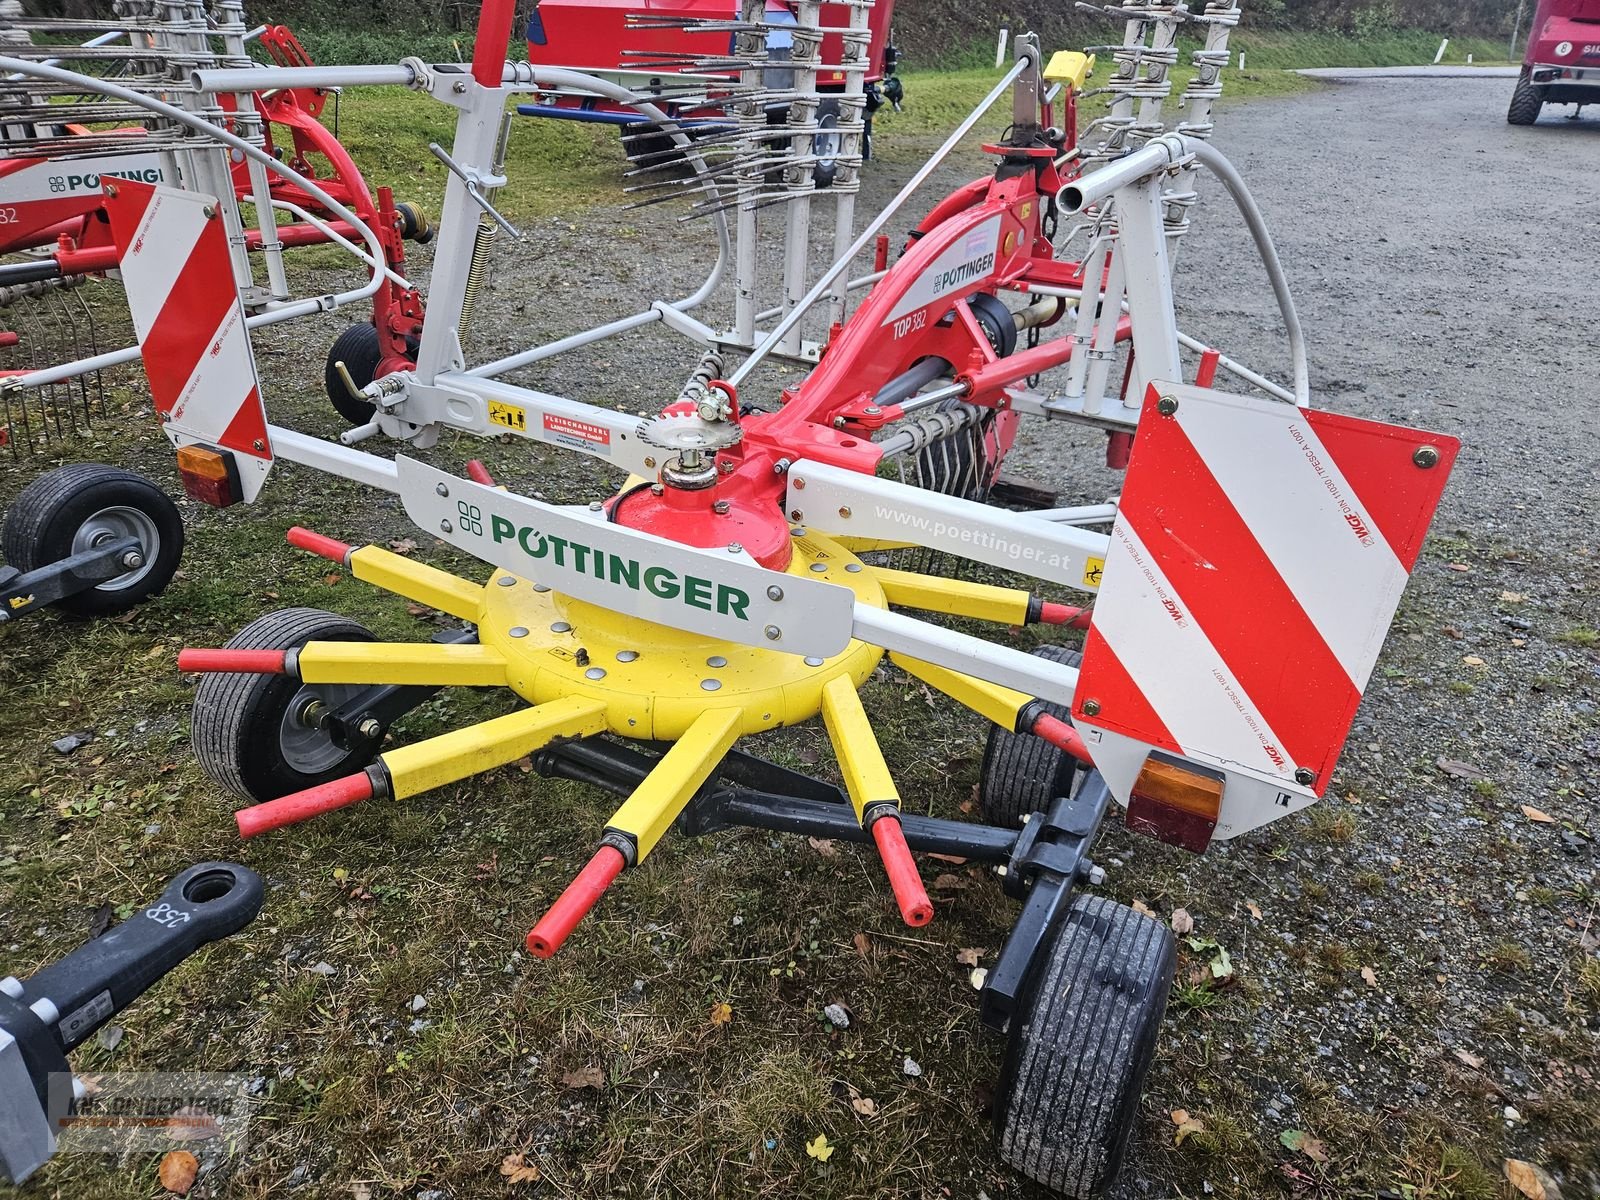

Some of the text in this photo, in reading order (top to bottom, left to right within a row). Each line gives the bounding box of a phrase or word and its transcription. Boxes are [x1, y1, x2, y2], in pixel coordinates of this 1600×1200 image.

[893, 309, 927, 341] TOP 382
[545, 415, 608, 436] FLEISCHANDERL
[550, 423, 587, 438] LANDTECHNIK
[1288, 424, 1305, 445] 10071
[1305, 450, 1326, 476] TPESC
[1324, 479, 1341, 499] 11030
[1338, 499, 1351, 514] DIN
[1344, 513, 1368, 538] WGF
[875, 505, 1072, 570] www.poettinger.at
[1143, 568, 1158, 586] 11030
[1155, 586, 1167, 599] DIN
[1161, 599, 1183, 621] WGF
[1244, 715, 1260, 733] 11030
[1263, 744, 1285, 766] WGF
